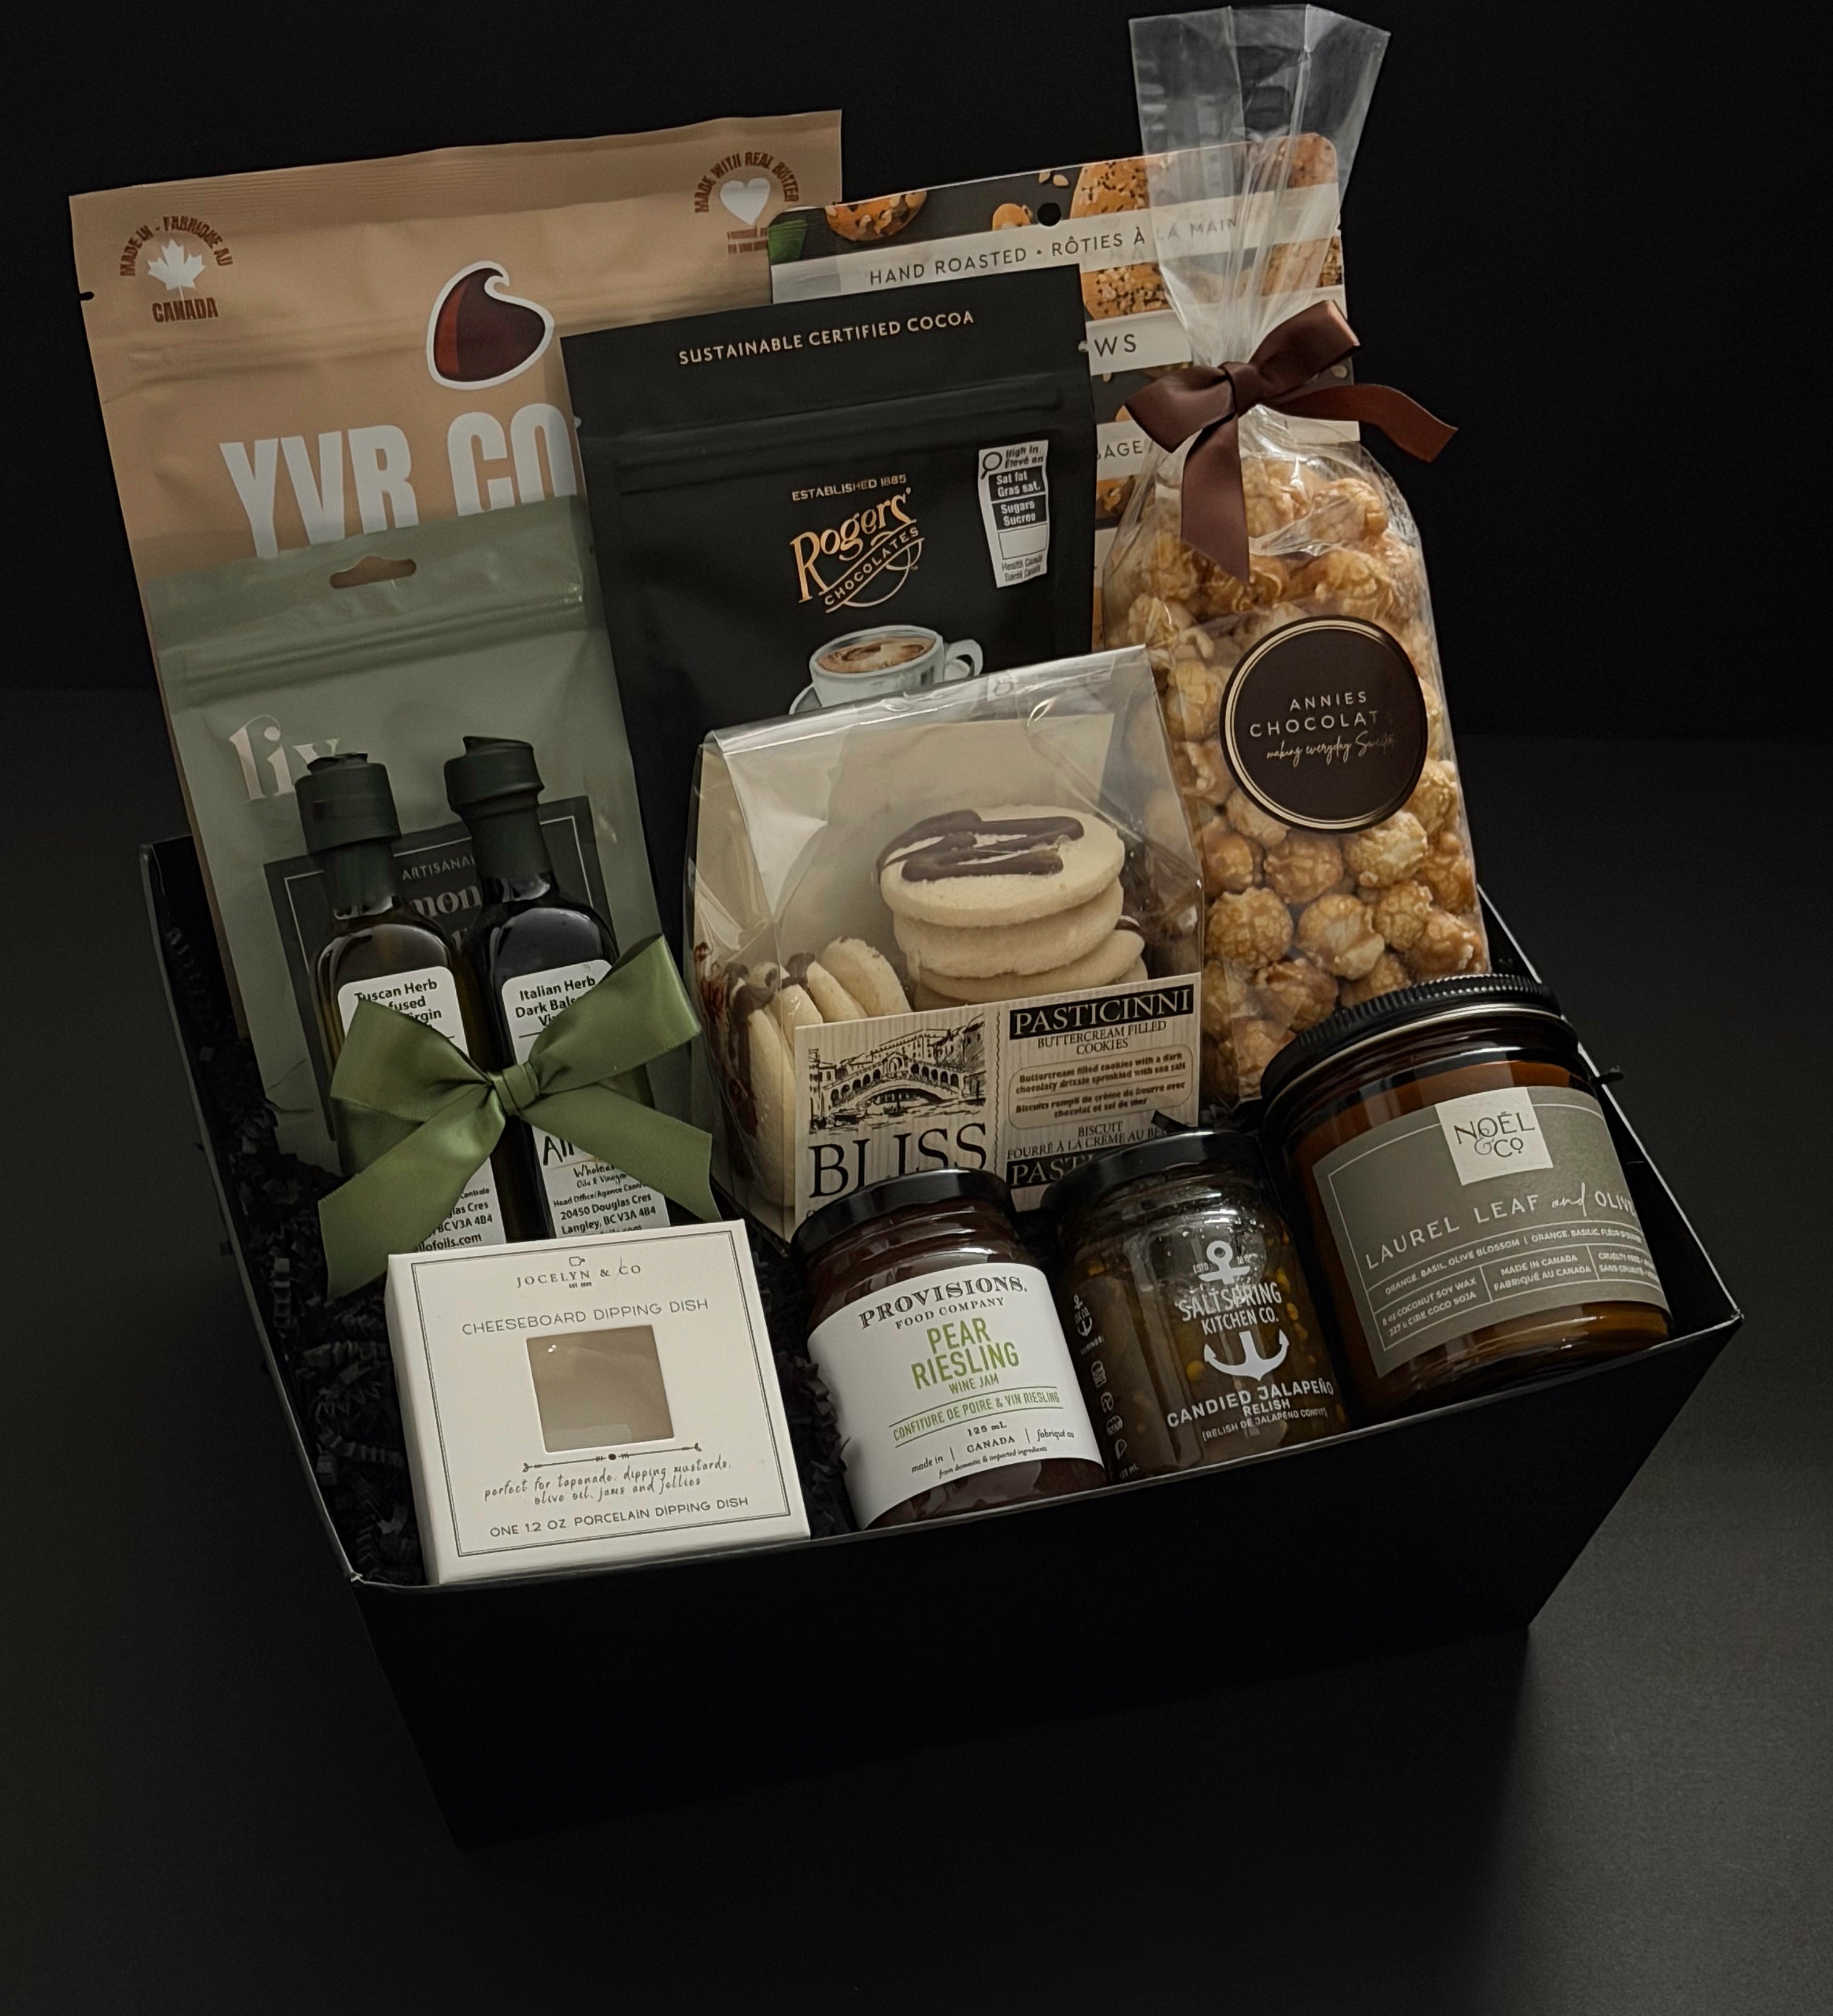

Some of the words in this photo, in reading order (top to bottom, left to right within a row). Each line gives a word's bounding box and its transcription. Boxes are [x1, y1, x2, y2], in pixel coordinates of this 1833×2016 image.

[695, 175, 716, 213] MADE
[710, 153, 741, 178] WITH
[744, 152, 774, 169] REAL
[772, 162, 799, 202] BUTTER
[120, 238, 142, 276] MADE
[136, 225, 153, 241] IN
[213, 247, 233, 266] AU
[870, 263, 924, 285] HAND
[935, 247, 1027, 275] ROASTED
[1052, 233, 1123, 256] RÔTIES
[1134, 227, 1144, 245] À
[152, 297, 218, 322] CANADA
[679, 335, 803, 365] SUSTAINABLE
[809, 321, 901, 346] CERTIFIED
[907, 310, 974, 332] COCOA
[1006, 447, 1026, 458] High
[219, 425, 419, 558] YVR
[792, 478, 877, 501] ESTABLISHED
[997, 473, 1012, 486] Sat
[1014, 470, 1027, 482] fat
[997, 486, 1020, 498] Gras
[1001, 501, 1035, 515] Sugars
[1003, 513, 1036, 527] Sucres
[825, 526, 919, 606] CHOCOLATES
[1289, 691, 1366, 712] ANNIES
[1267, 741, 1302, 767] making
[1306, 736, 1352, 765] everyday
[354, 987, 401, 1001] Tuscan
[404, 978, 438, 995] Herb
[519, 985, 561, 1001] Italian
[564, 975, 596, 992] Herb
[515, 1002, 547, 1018] Dark
[1013, 989, 1190, 1035] PASTICINNI
[1037, 1026, 1125, 1049] BUTTERCREAM
[1128, 1020, 1167, 1036] FILLED
[1077, 1038, 1129, 1055] COOKIES
[1101, 1060, 1132, 1071] cookies
[1135, 1056, 1154, 1065] with
[1078, 1120, 1123, 1137] BISCUIT
[1454, 1110, 1535, 1145] NOËL
[1007, 1141, 1053, 1160] FOURRÉ
[1067, 1138, 1081, 1150] LA
[1127, 1129, 1144, 1141] AU
[467, 1201, 489, 1212] Cres
[553, 1196, 573, 1207] Head
[561, 1206, 590, 1221] 20450
[592, 1198, 630, 1213] Douglas
[632, 1193, 652, 1204] Cres
[452, 1218, 473, 1230] V3A
[475, 1213, 493, 1225] 4B4
[561, 1220, 602, 1235] Langley,
[603, 1215, 616, 1226] BC
[617, 1210, 637, 1221] V3A
[638, 1206, 656, 1217] 4B4
[1365, 1217, 1460, 1270] LAUREL
[1474, 1193, 1539, 1224] LEAF
[1551, 1183, 1587, 1217] and
[1448, 1250, 1474, 1266] OLIVE
[1476, 1238, 1520, 1257] BLOSSOM
[1501, 1261, 1529, 1276] MADE
[1530, 1260, 1540, 1269] IN
[1541, 1254, 1578, 1266] CANADA
[516, 1270, 590, 1288] JOCELYN
[599, 1268, 610, 1278] &
[618, 1264, 641, 1276] CO
[1541, 1269, 1554, 1279] AU
[1556, 1266, 1592, 1277] CANADA
[1397, 1293, 1435, 1317] COCONUT
[1436, 1286, 1453, 1299] SOY
[1455, 1277, 1477, 1291] WAX
[1408, 1311, 1427, 1326] CIRE
[1428, 1300, 1452, 1315] COCO
[1453, 1291, 1477, 1305] SOJA
[462, 1311, 586, 1335] CHEESEBOARD
[593, 1303, 661, 1321] DIPPING
[669, 1299, 708, 1313] DISH
[895, 1310, 934, 1330] FOOD
[939, 1297, 1004, 1316] COMPANY
[1201, 1309, 1258, 1335] KITCHEN
[1259, 1306, 1279, 1324] CO.
[926, 1317, 991, 1355] PEAR
[911, 1341, 1020, 1390] RIESLING
[949, 1378, 976, 1395] WINE
[979, 1373, 1000, 1388] JAM
[893, 1411, 944, 1441] CONFITURE
[946, 1407, 960, 1421] DE
[963, 1398, 994, 1417] POIRE
[995, 1397, 1003, 1408] &
[1004, 1394, 1023, 1406] VIN
[1024, 1391, 1060, 1404] RIESLING
[1167, 1390, 1251, 1428] CANDIED
[1257, 1377, 1334, 1401] JALAPEÑO
[1243, 1398, 1290, 1417] RELISH
[967, 1426, 987, 1437] 125
[912, 1459, 933, 1474] made
[935, 1455, 944, 1465] in
[966, 1435, 1015, 1453] CANADA
[484, 1478, 528, 1501] perfect
[534, 1476, 550, 1492] for
[623, 1464, 666, 1481] dipping
[534, 1487, 564, 1506] olive
[596, 1485, 625, 1503] jams
[632, 1481, 655, 1494] and
[658, 1474, 701, 1495] jellies
[490, 1523, 519, 1538] ONE
[574, 1507, 651, 1527] PORCELAIN
[655, 1501, 711, 1517] DIPPING
[717, 1496, 749, 1509] DISH
